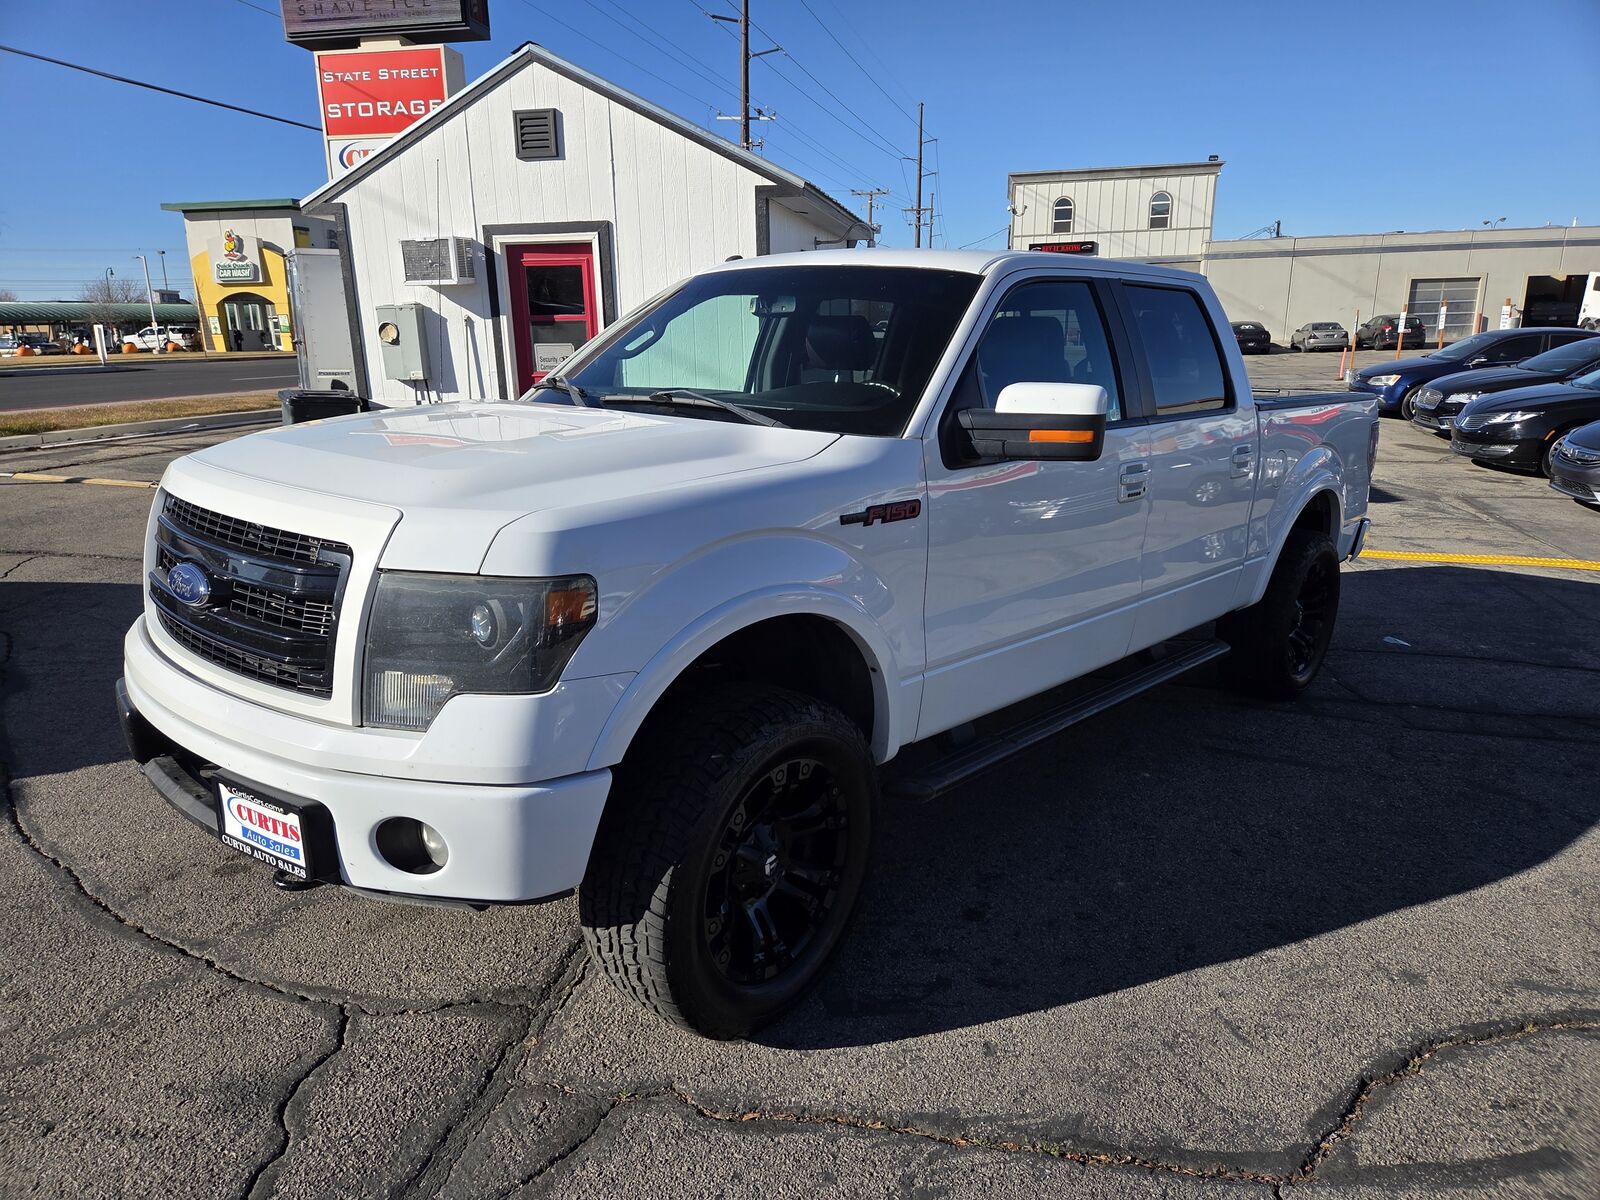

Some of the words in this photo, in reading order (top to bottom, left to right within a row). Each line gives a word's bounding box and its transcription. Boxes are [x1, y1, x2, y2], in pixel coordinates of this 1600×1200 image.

[298, 0, 374, 16] SHAVE
[323, 71, 371, 82] STATE
[378, 67, 439, 80] STREET
[231, 269, 251, 277] WASH
[236, 803, 301, 842] CURTIS
[246, 830, 267, 845] Auto
[269, 841, 295, 857] Sales
[221, 834, 252, 854] CURTIS
[253, 850, 277, 866] AUTO
[278, 859, 307, 879] SALES
